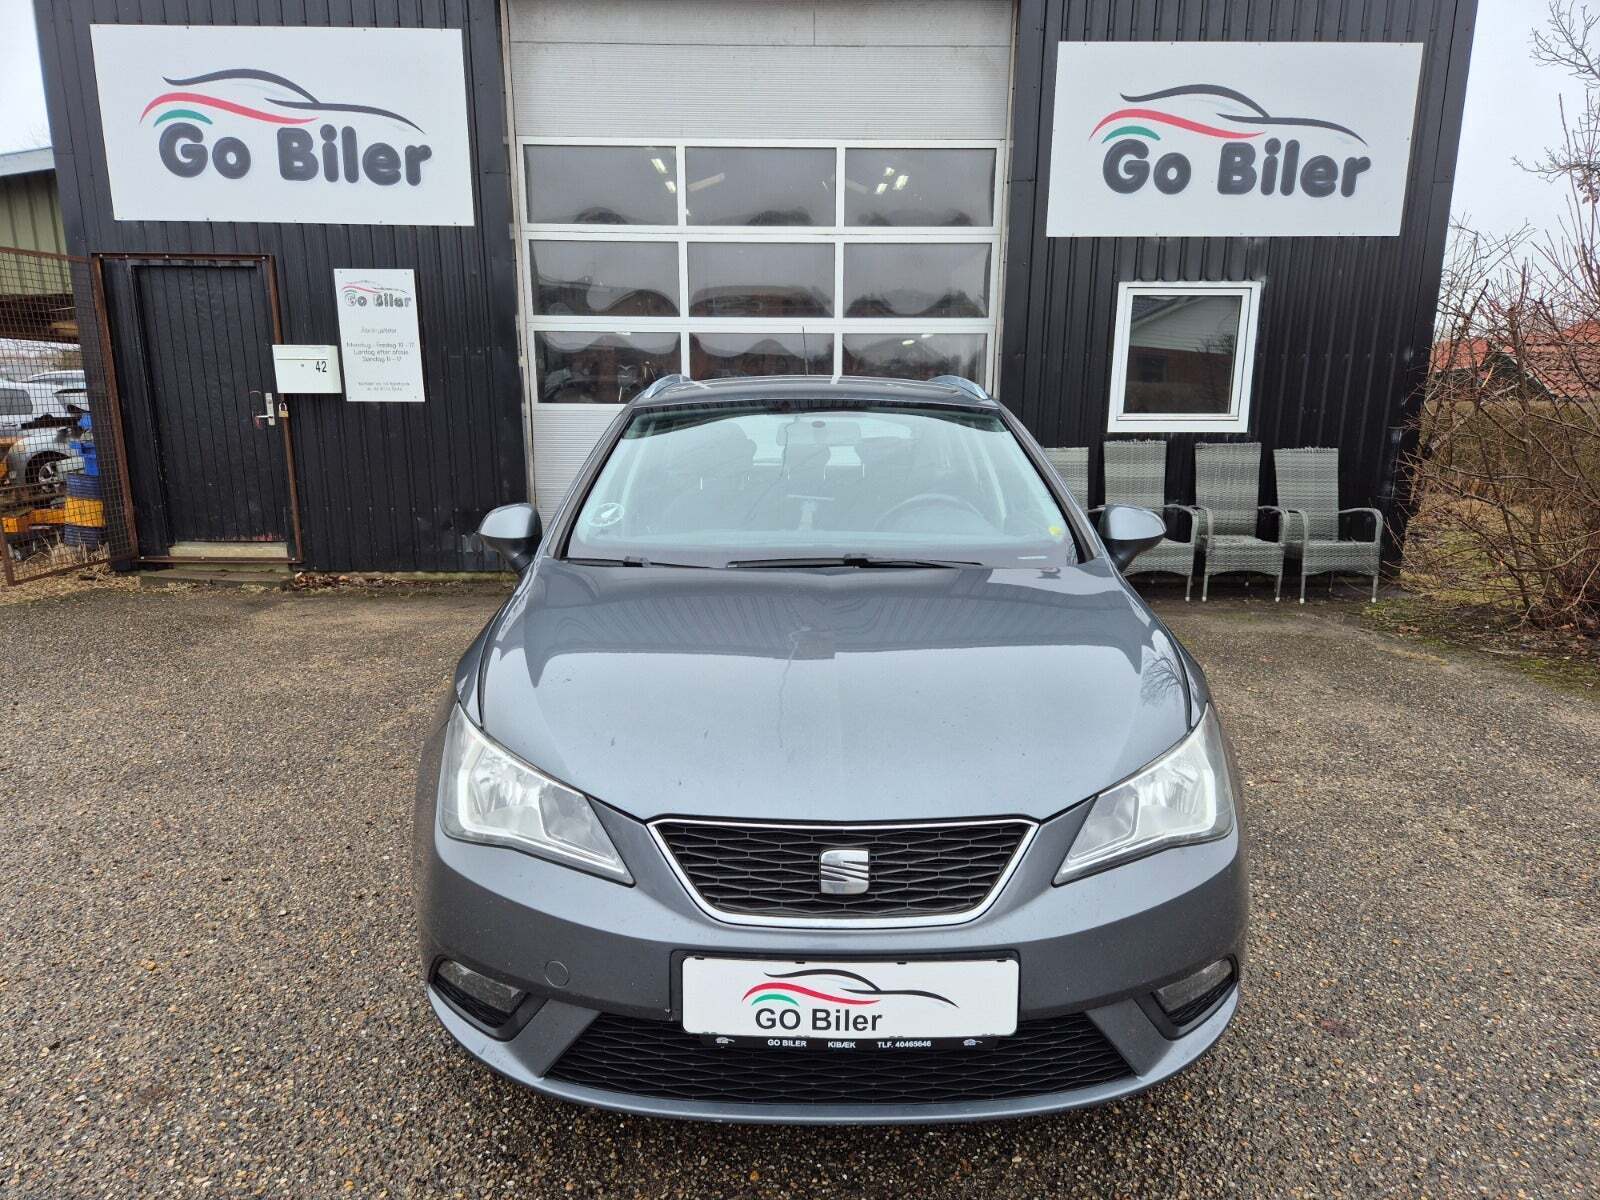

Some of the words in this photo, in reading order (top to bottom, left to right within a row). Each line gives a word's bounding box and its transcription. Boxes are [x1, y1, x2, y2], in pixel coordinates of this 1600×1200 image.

[159, 122, 251, 179] Go
[277, 123, 432, 186] Biler
[1103, 138, 1192, 194] Go
[1217, 137, 1372, 198] Biler
[344, 292, 368, 308] Go
[373, 292, 412, 308] Biler
[315, 360, 327, 373] 42
[755, 1008, 801, 1031] GO
[811, 1009, 883, 1032] Biler
[767, 1039, 781, 1047] GO
[782, 1039, 807, 1047] BILER
[827, 1040, 856, 1049] KIBÆK
[876, 1041, 894, 1049] TLF.
